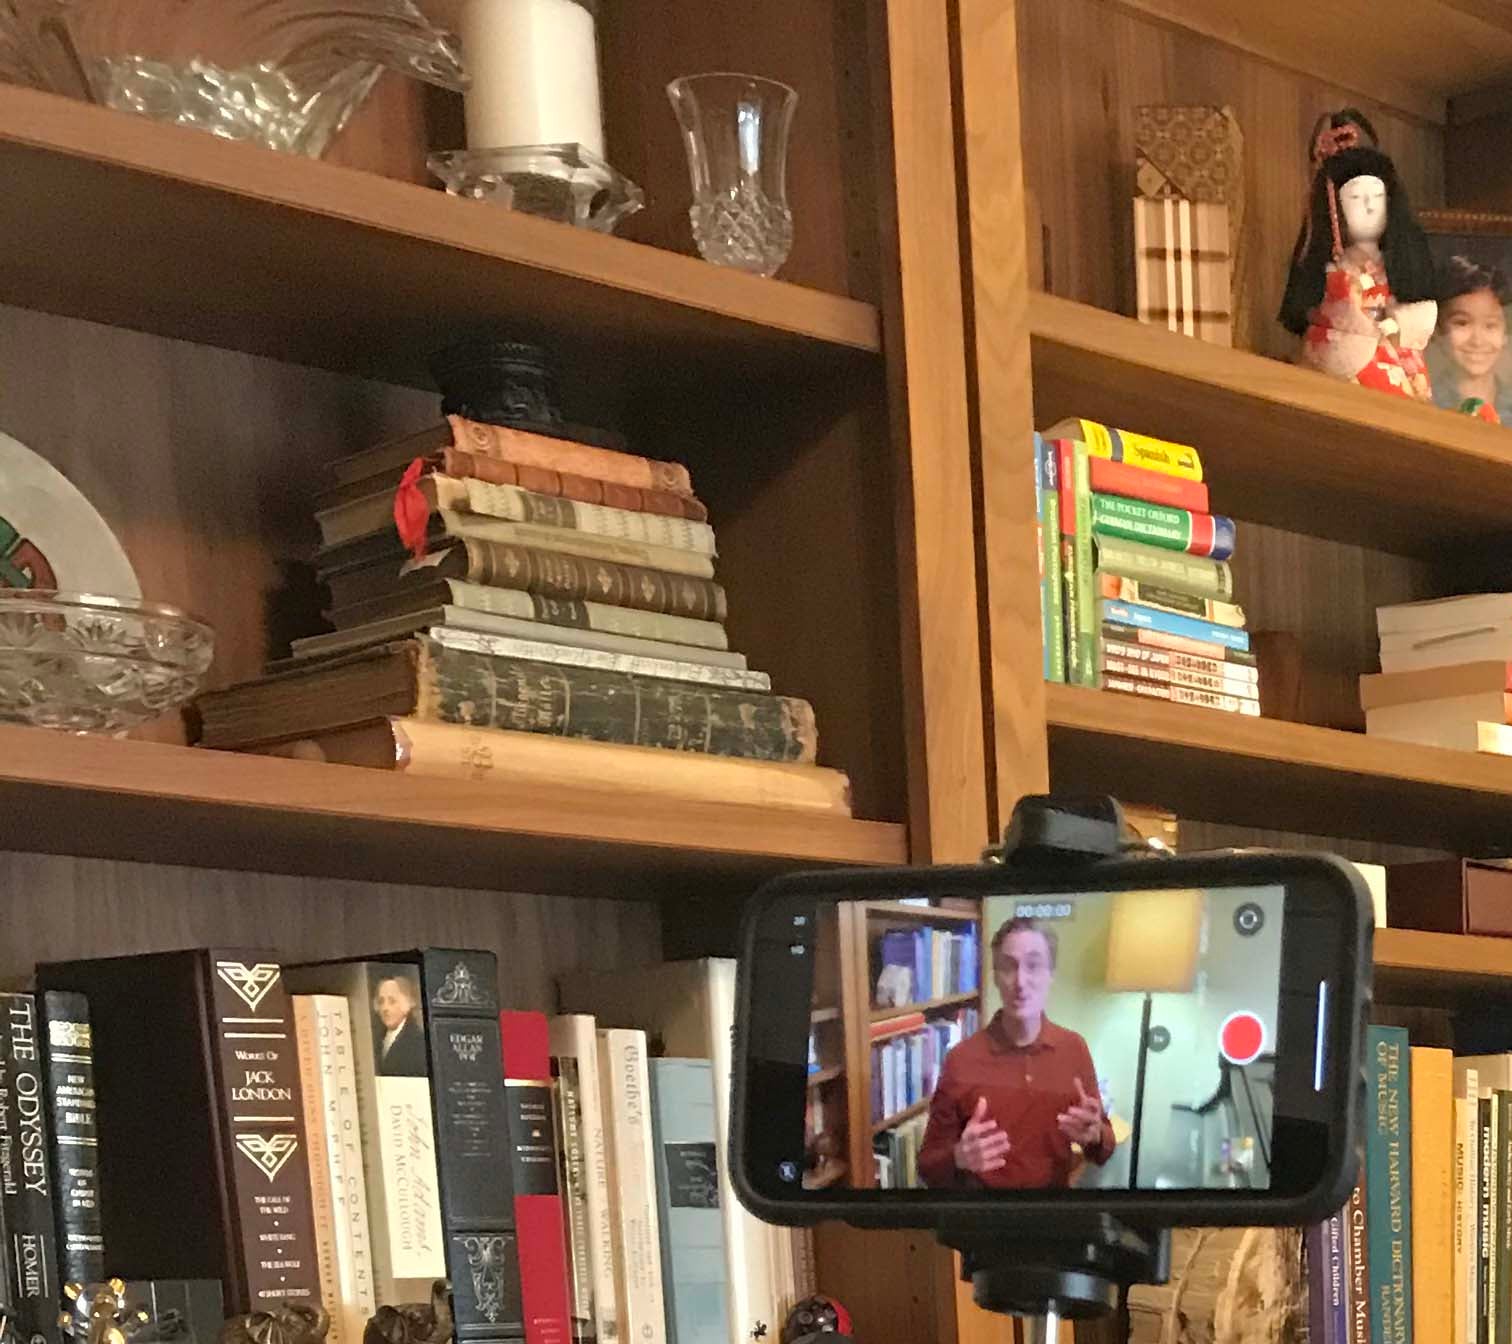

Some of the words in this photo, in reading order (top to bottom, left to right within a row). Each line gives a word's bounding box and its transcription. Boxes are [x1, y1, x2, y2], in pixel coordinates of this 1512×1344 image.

[10, 1003, 35, 1062] THE
[1376, 1040, 1388, 1069] OF
[1386, 1041, 1400, 1083] THE
[231, 1087, 292, 1101] LONDON
[245, 1070, 275, 1087] JACK
[624, 1045, 643, 1125] Goethe's
[1377, 1072, 1389, 1135] MUSIC
[16, 1073, 47, 1197] ODYSSEY
[389, 1104, 405, 1148] DAVID
[1387, 1086, 1400, 1135] NEW
[333, 1011, 350, 1096] TABLE
[342, 1119, 354, 1153] OF
[348, 1176, 369, 1316] CONTENTS
[1388, 1141, 1403, 1233] HARVARD
[1482, 1126, 1491, 1198] modern
[592, 1127, 606, 1186] NATURE
[599, 1207, 613, 1279] WALKING
[1481, 1204, 1491, 1259] music
[1331, 1217, 1340, 1252] Gifted
[1353, 1209, 1366, 1295] Chamber
[22, 1234, 41, 1298] HOMER
[1331, 1255, 1341, 1306] Children
